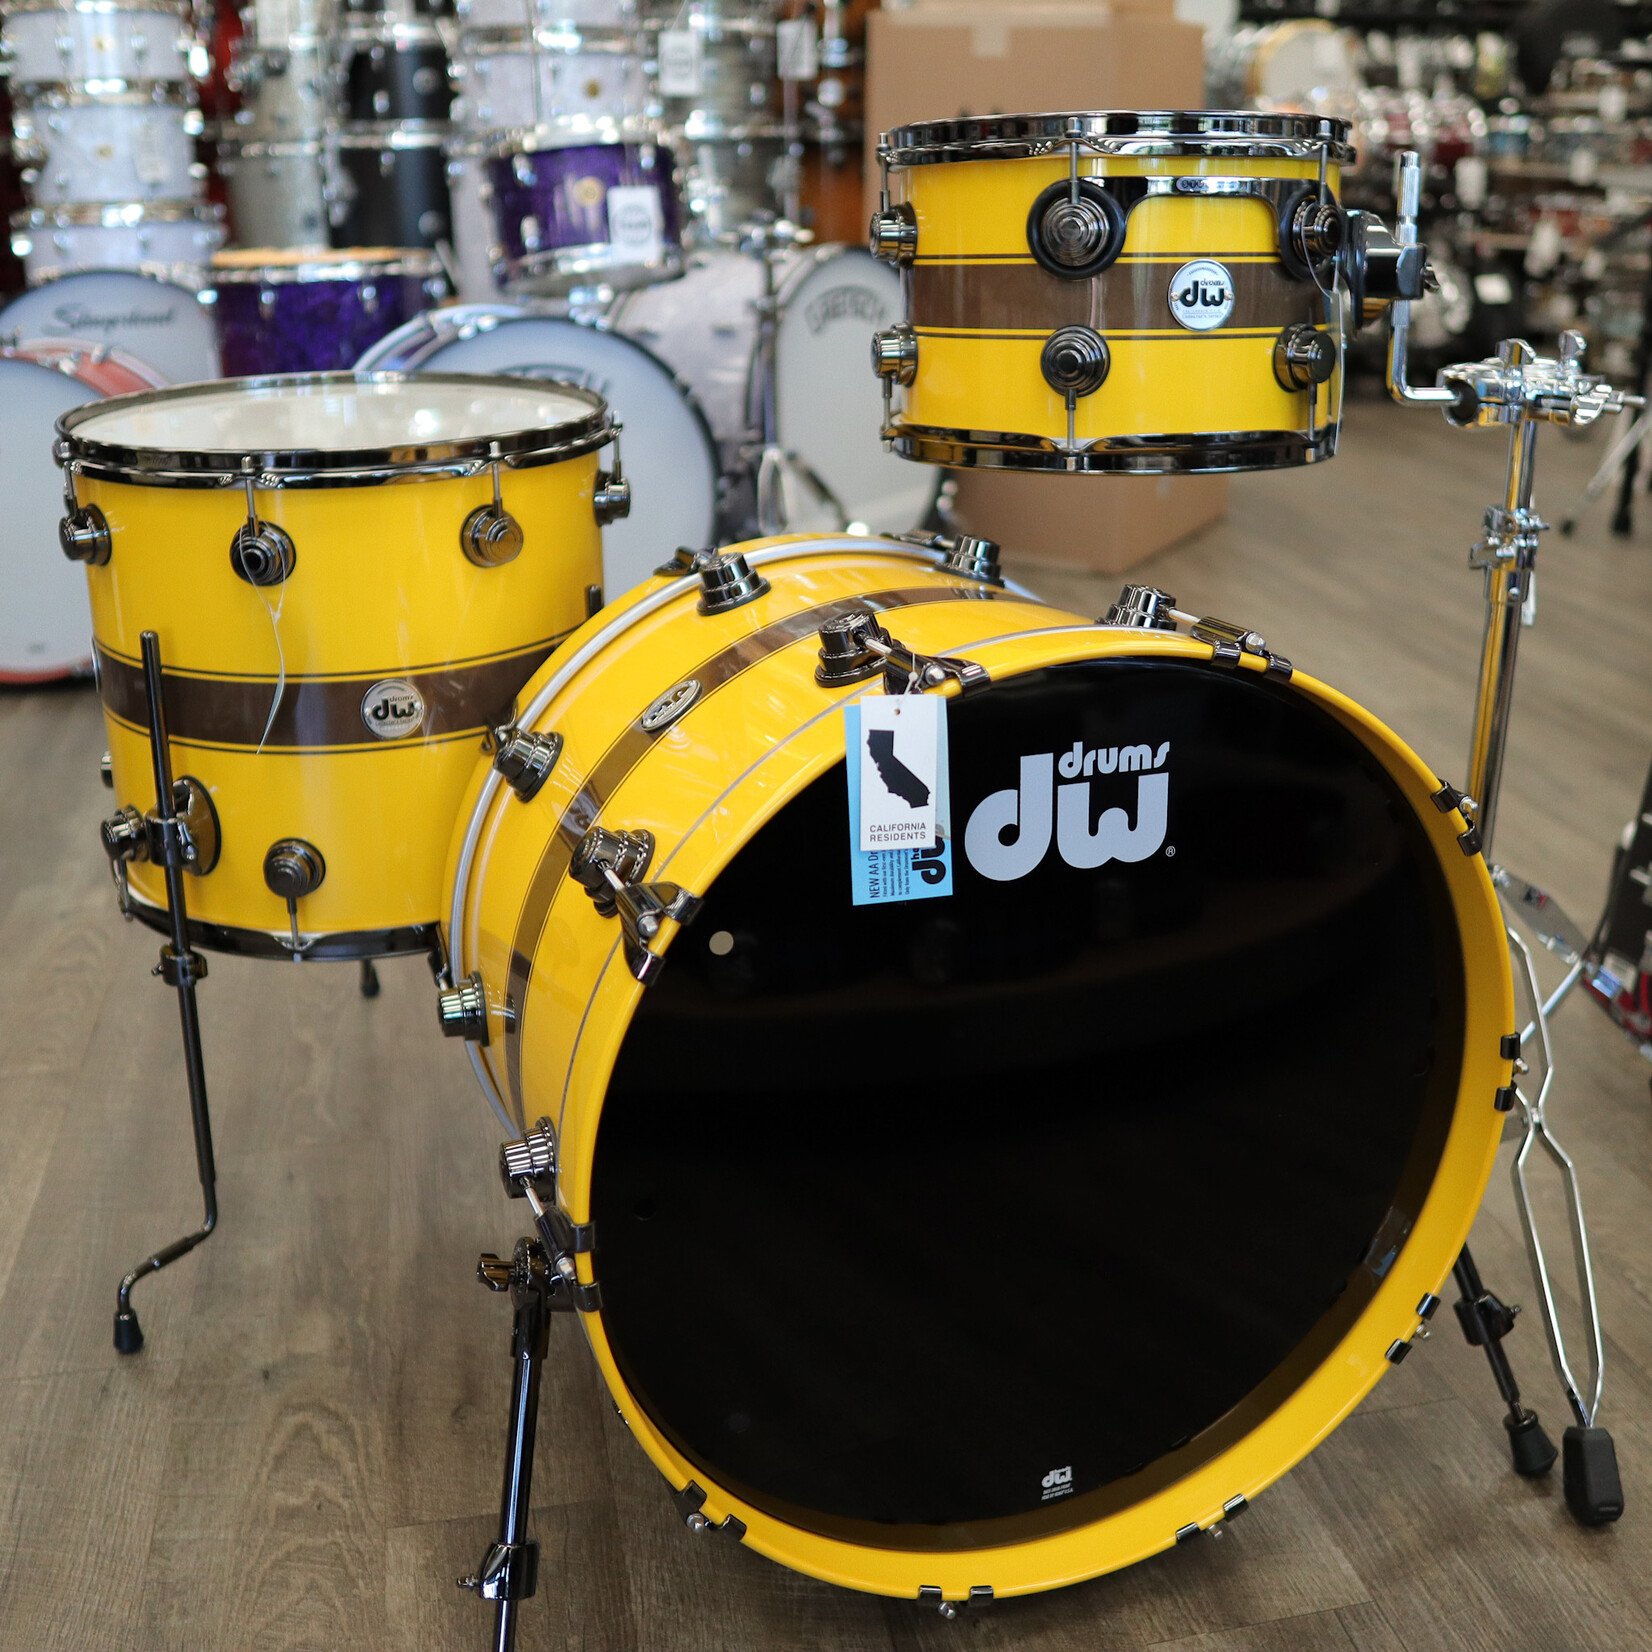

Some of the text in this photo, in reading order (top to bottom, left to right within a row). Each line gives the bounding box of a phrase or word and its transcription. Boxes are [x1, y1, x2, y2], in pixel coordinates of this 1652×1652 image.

[1179, 280, 1225, 307] dw
[371, 698, 415, 721] dw
[1058, 741, 1170, 779] drums
[965, 752, 1169, 881] dw
[869, 823, 926, 833] CALIFORNIA
[869, 832, 926, 842] RESIDENTS
[869, 863, 880, 876] AA
[869, 877, 880, 899] NEW
